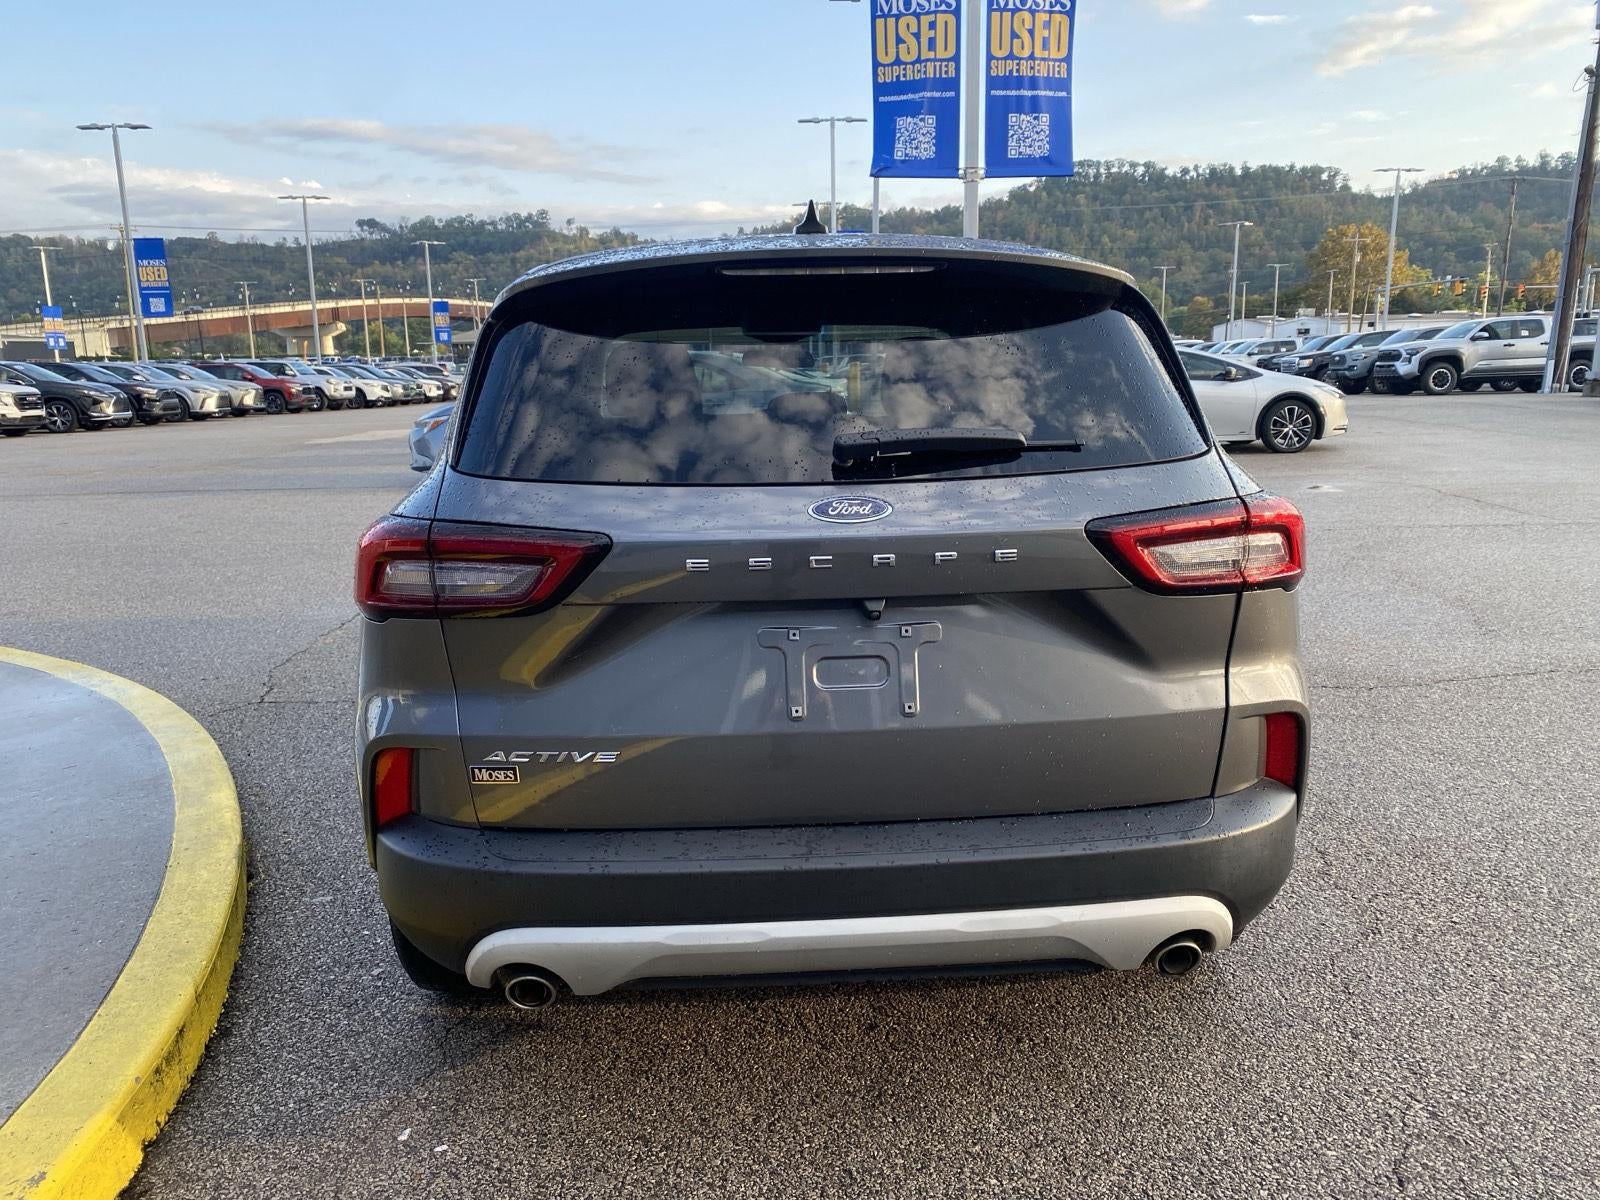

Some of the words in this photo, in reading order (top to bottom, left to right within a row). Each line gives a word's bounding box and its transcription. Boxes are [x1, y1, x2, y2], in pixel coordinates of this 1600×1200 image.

[876, 13, 956, 64] USED
[991, 11, 1070, 58] USED
[877, 62, 956, 83] SUPERCENTER
[990, 60, 1068, 78] SUPERCENTER
[139, 266, 168, 282] USED
[828, 500, 872, 515] Ford
[685, 548, 1018, 573] ESCAPE
[482, 750, 621, 763] ACTIVE
[474, 768, 514, 781] MOSES
